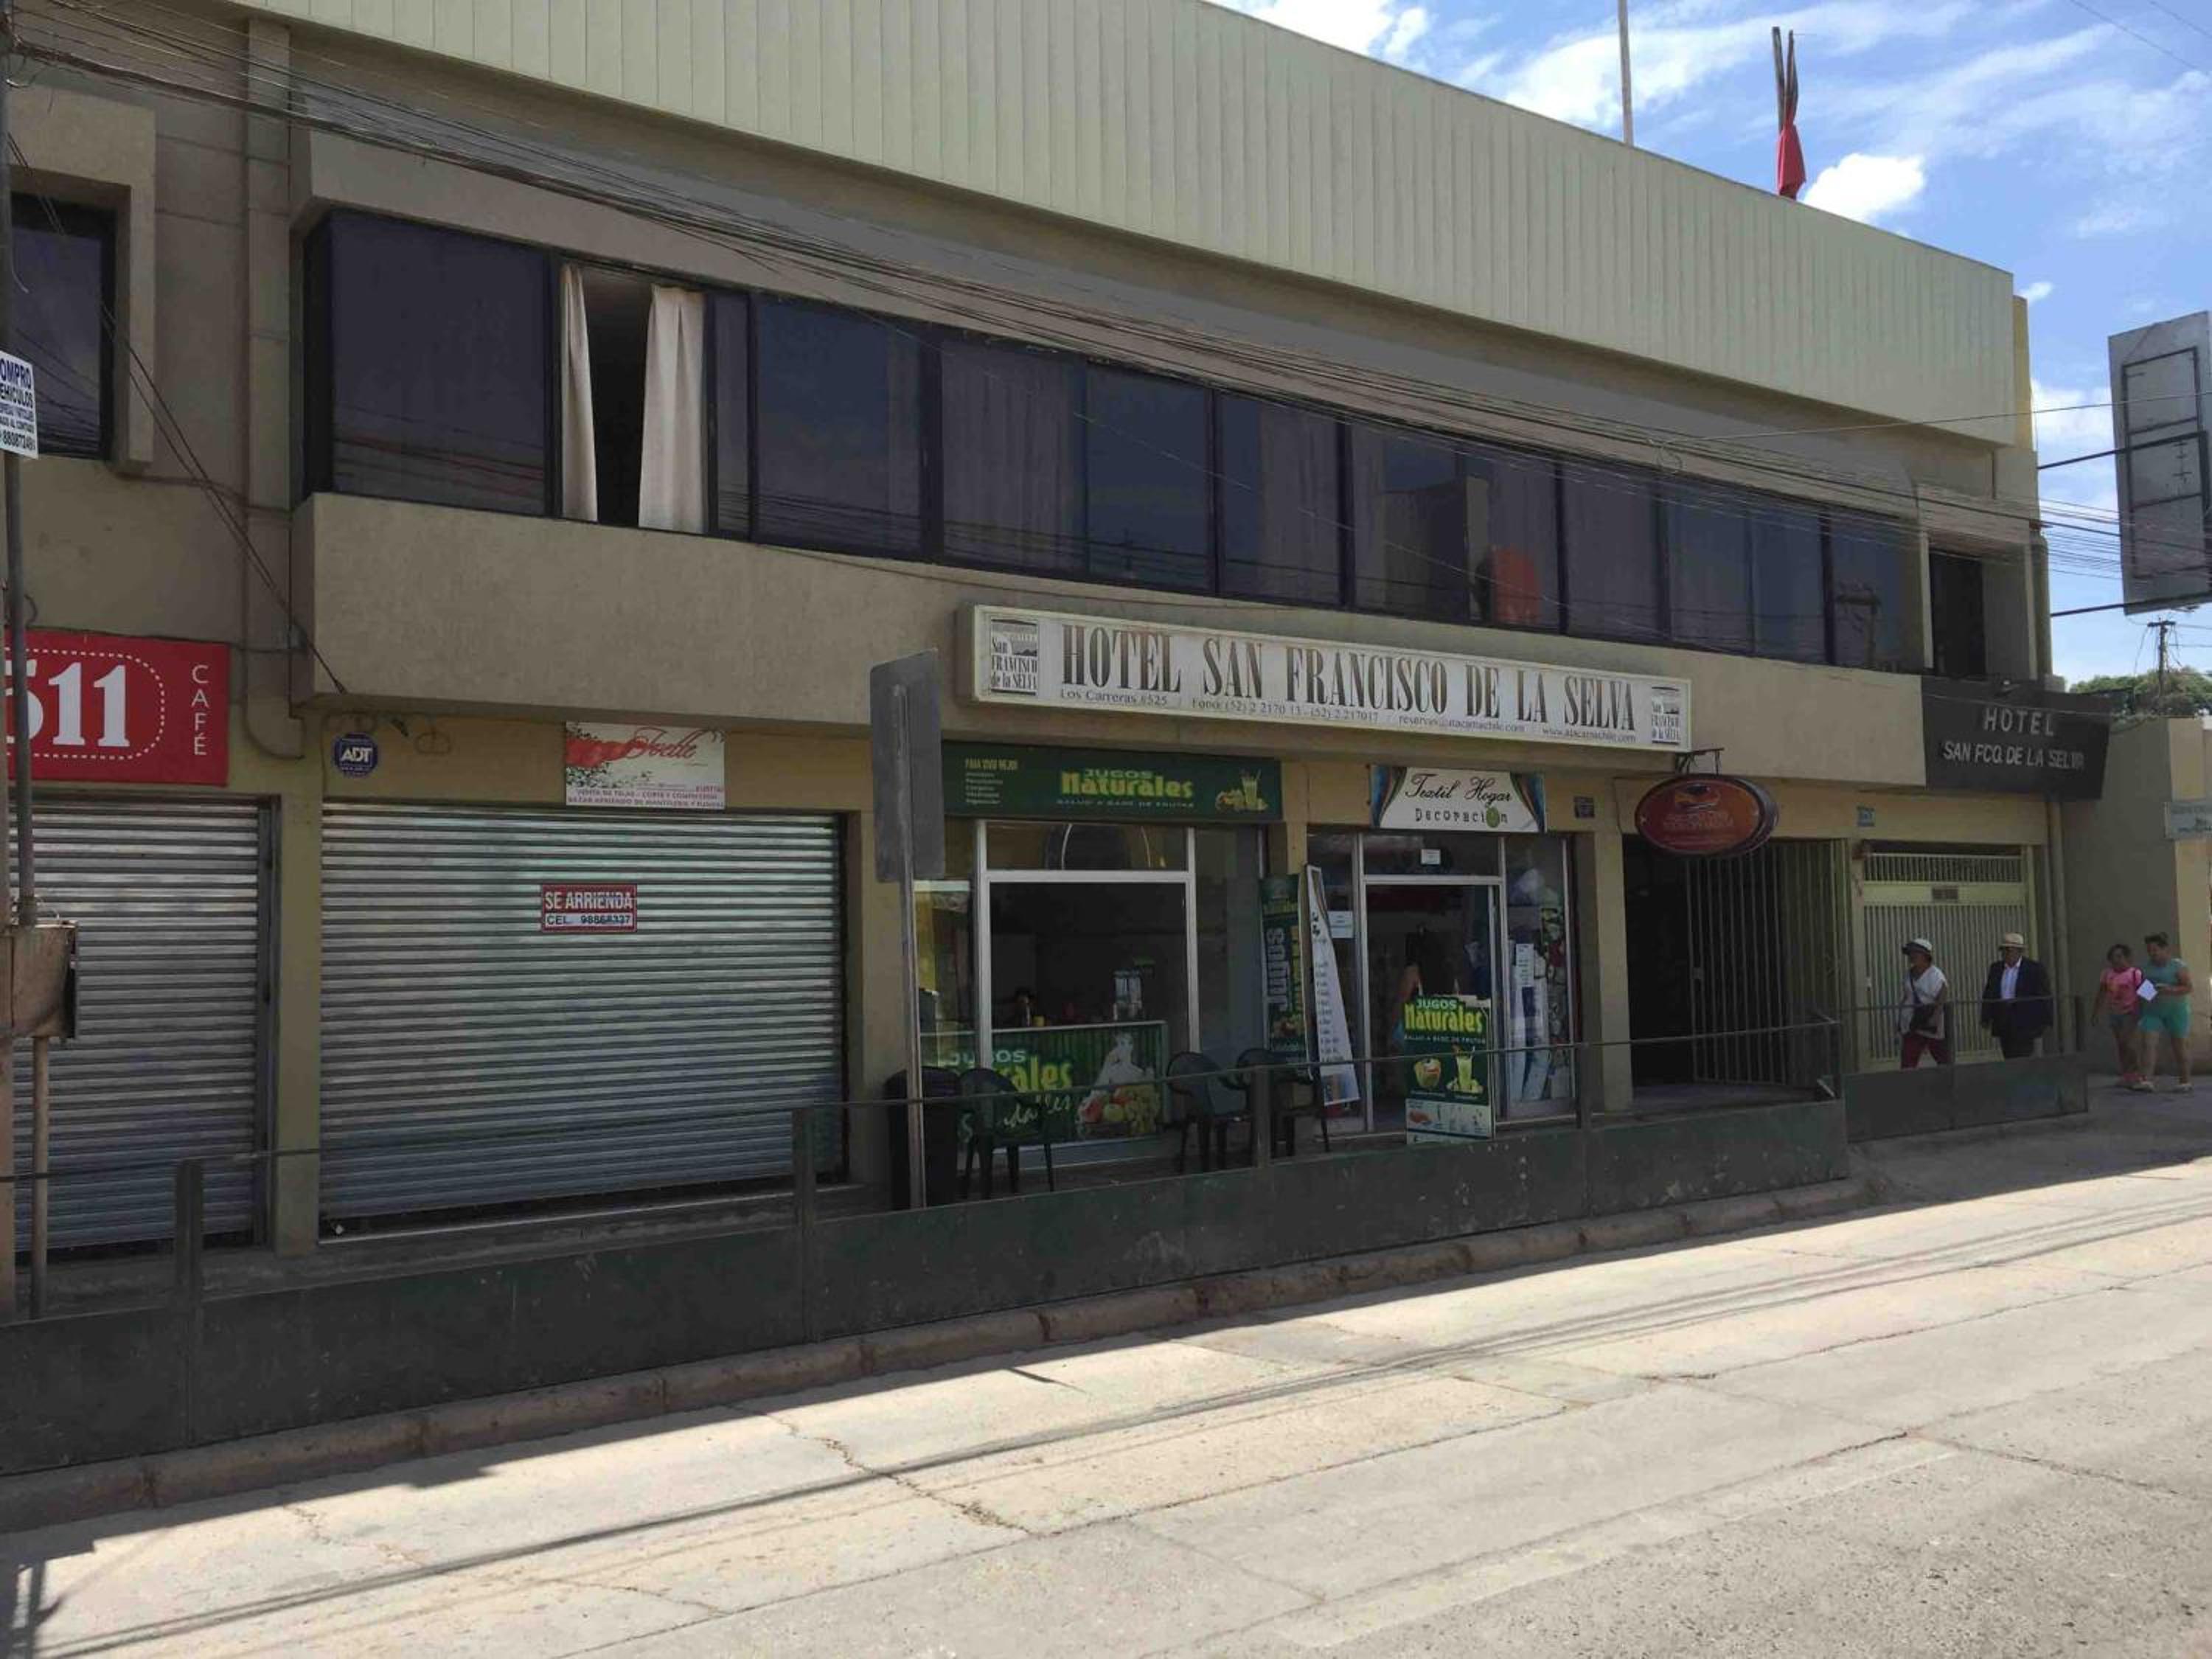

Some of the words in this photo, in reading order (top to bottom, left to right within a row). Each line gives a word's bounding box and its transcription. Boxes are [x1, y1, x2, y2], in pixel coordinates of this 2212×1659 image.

[0, 358, 31, 389] OMPRO
[0, 383, 33, 408] EHICULOS
[1062, 623, 1180, 692] HOTEL
[1203, 637, 1262, 698] SAN
[1286, 646, 1447, 714] FRANCISCO
[1465, 664, 1500, 720] DE
[1517, 669, 1548, 723] LA
[1564, 675, 1635, 731] SELVA
[1060, 689, 1082, 700] Los
[191, 664, 209, 756] CAFÉ
[1983, 706, 2054, 737] HOTEL
[340, 746, 373, 763] ADT
[1942, 740, 1971, 762] SAN
[2006, 745, 2024, 765] DE
[2026, 747, 2044, 767] LA
[1061, 771, 1193, 799] Naturales
[1085, 768, 1152, 779] JUGOS
[1405, 773, 1461, 799] Textil
[1464, 776, 1512, 806] Hogar
[545, 891, 563, 909] SE
[566, 892, 633, 909] ARRIENDA
[1416, 998, 1458, 1009] JUGOS
[1404, 1003, 1483, 1034] Naturales
